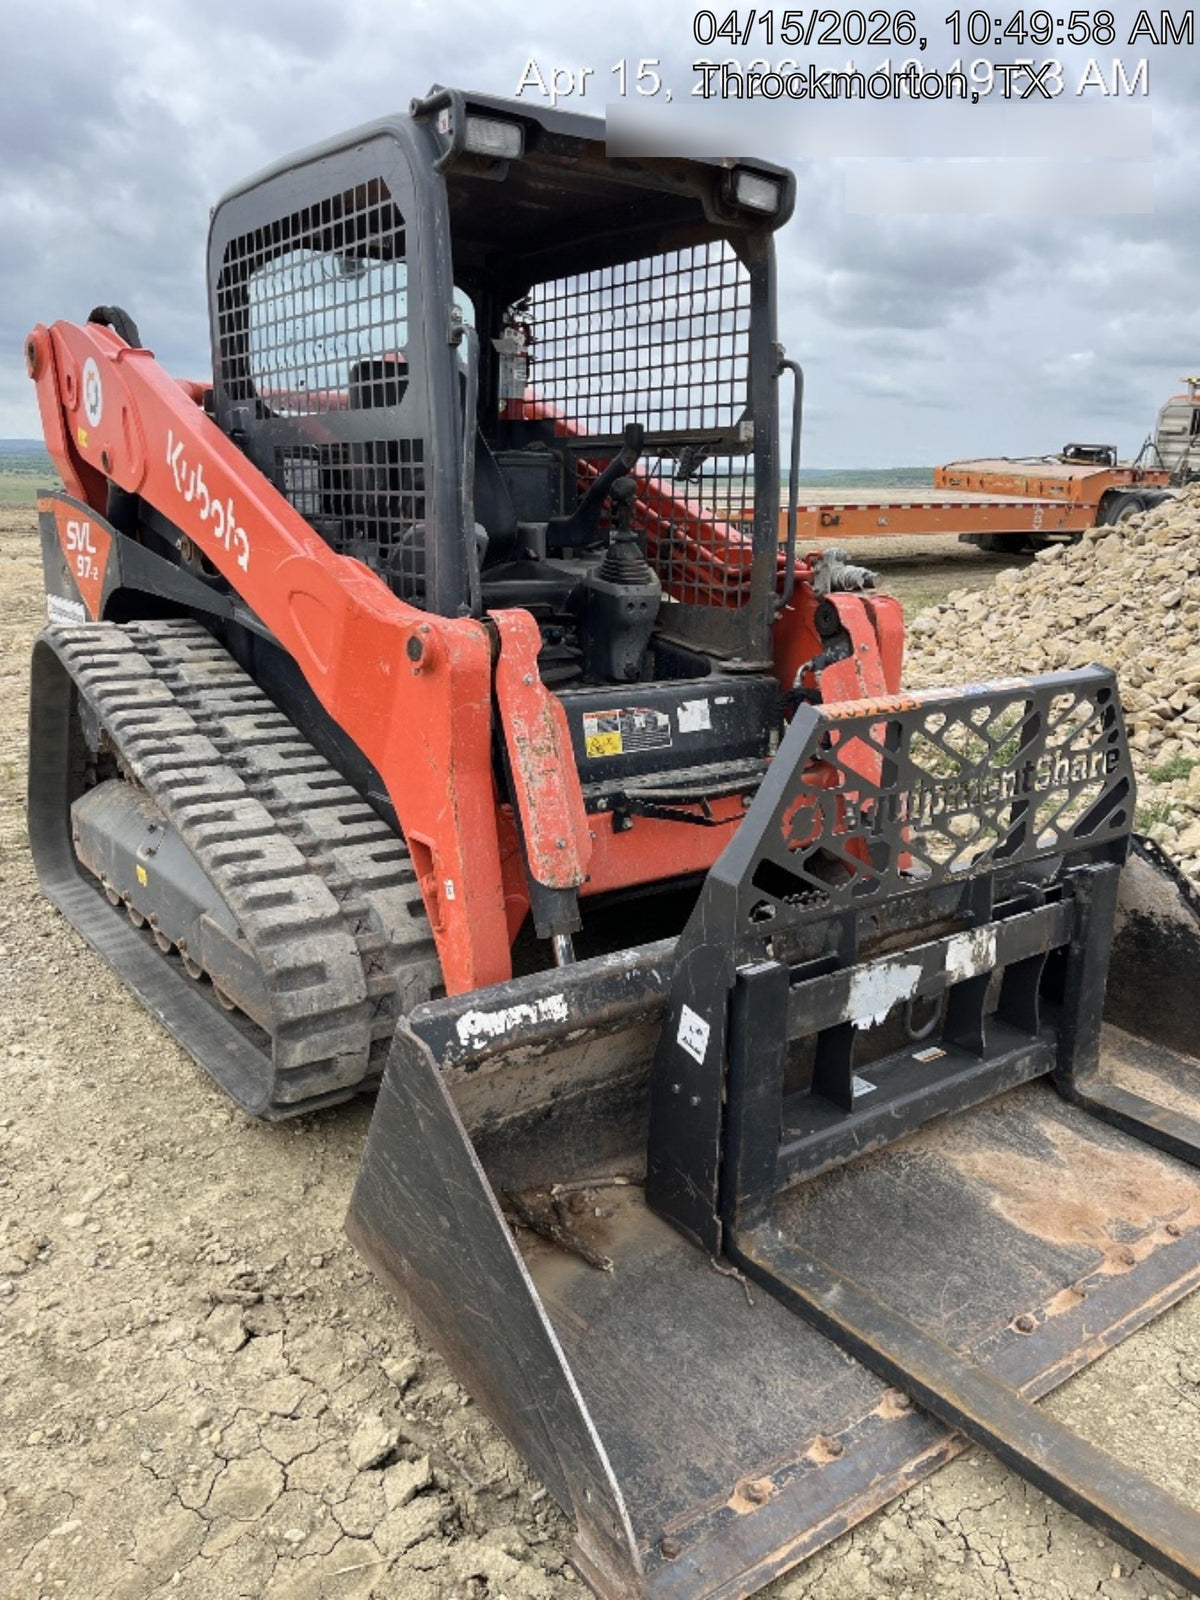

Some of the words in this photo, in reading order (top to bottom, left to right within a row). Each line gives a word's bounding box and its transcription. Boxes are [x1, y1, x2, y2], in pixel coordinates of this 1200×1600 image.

[166, 428, 250, 574] Kubota
[66, 520, 97, 554] SVL
[77, 553, 99, 581] 97-2
